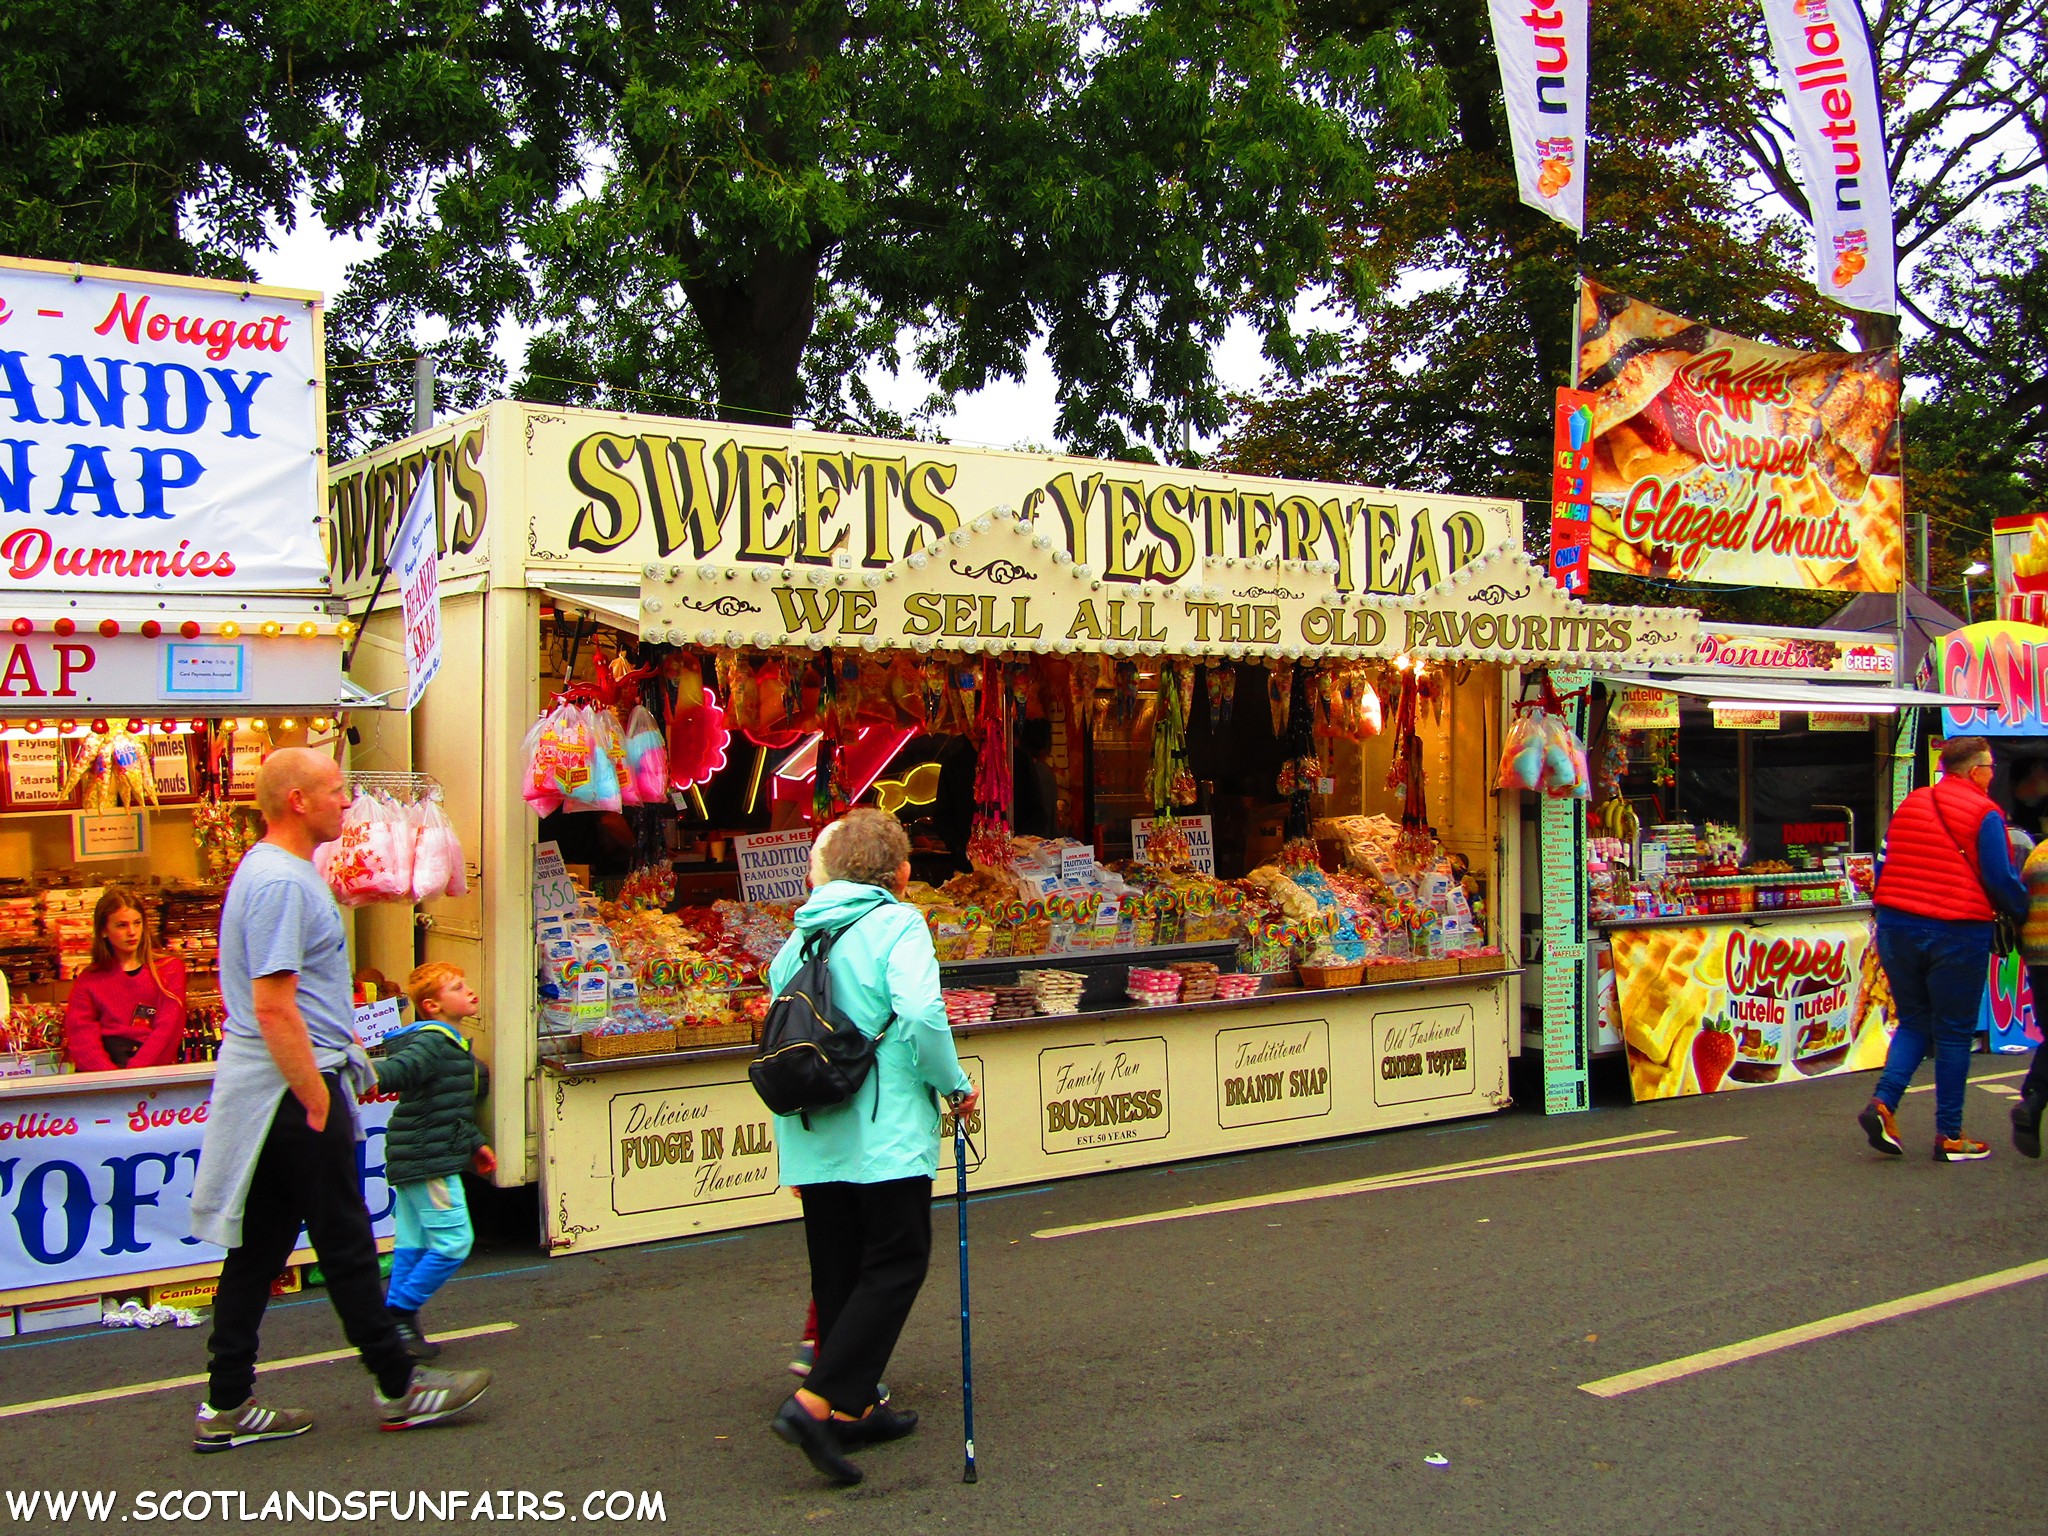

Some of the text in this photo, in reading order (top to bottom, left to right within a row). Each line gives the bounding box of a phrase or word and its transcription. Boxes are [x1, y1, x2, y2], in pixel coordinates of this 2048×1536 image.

[1795, 22, 1862, 212] nutella
[94, 292, 291, 361] Nougat
[1678, 348, 1792, 424] Coffee
[1557, 451, 1574, 469] ICE
[1697, 411, 1812, 490] Crepes
[568, 432, 957, 568] SWEETS
[1046, 471, 1485, 596] YESTERYEAR
[1555, 501, 1590, 522] SLUSH
[1624, 477, 1860, 573] Glazed Donuts
[1, 528, 236, 580] Dummies
[1555, 546, 1581, 568] ONLY
[771, 587, 1633, 654] WE SELL ALL THE OLD FAVOURITES
[413, 603, 437, 675] SNAP
[1699, 634, 1810, 668] Donuts
[1845, 655, 1893, 671] CREPES
[1622, 687, 1663, 701] nutella
[1944, 636, 2048, 727] CAN
[1617, 703, 1669, 725] Crepes
[18, 739, 57, 750] Flying
[154, 773, 187, 793] onuts
[747, 834, 785, 846] LOOK
[742, 846, 811, 870] TRADITIO
[1064, 858, 1092, 868] TRADITIONAL
[744, 868, 790, 881] FAMOUS
[747, 879, 805, 903] BRANDY
[1553, 949, 1580, 957] WAFFLES
[1725, 930, 1847, 996] Crepes
[367, 1023, 378, 1031] or
[372, 1006, 396, 1018] each
[1730, 998, 1785, 1025] nutella
[360, 1035, 373, 1043] or
[1384, 1013, 1463, 1053] Old Fashioned
[7, 1068, 32, 1077] each
[1055, 1052, 1141, 1096] Family Run
[1380, 1046, 1468, 1081] CINDER TOFFEE
[1224, 1066, 1329, 1109] BRANDY SNAP
[128, 1101, 211, 1132] Swee
[624, 1102, 711, 1135] Delicious
[1047, 1088, 1163, 1134] BUSINESS
[620, 1121, 773, 1179] FUDGE IN ALL
[1076, 1128, 1138, 1146] EST. 50 YEARS
[692, 1164, 769, 1199] Flavours
